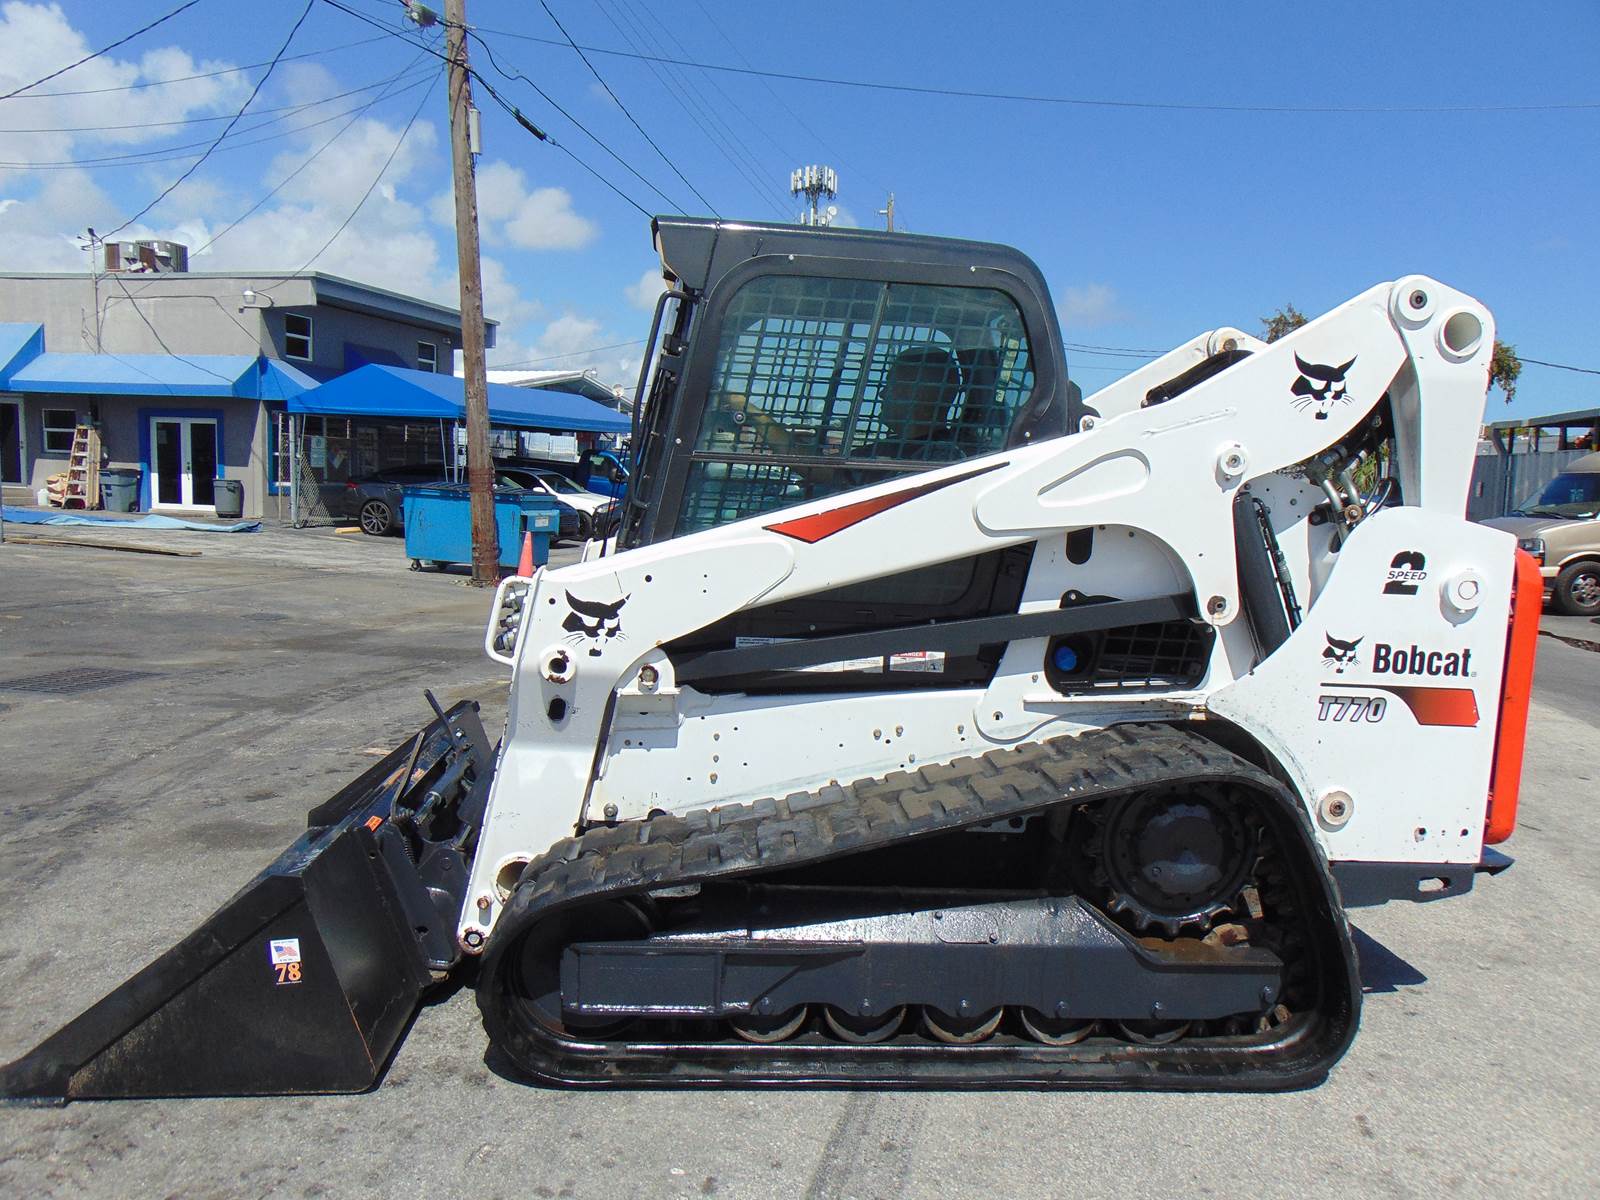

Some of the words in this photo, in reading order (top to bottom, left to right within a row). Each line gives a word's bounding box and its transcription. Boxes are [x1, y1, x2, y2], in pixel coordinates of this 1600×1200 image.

[1382, 551, 1426, 595] 2
[1387, 570, 1427, 581] SPEED
[1373, 643, 1471, 677] Bobcat
[1319, 695, 1387, 723] T770
[275, 962, 302, 982] 78
